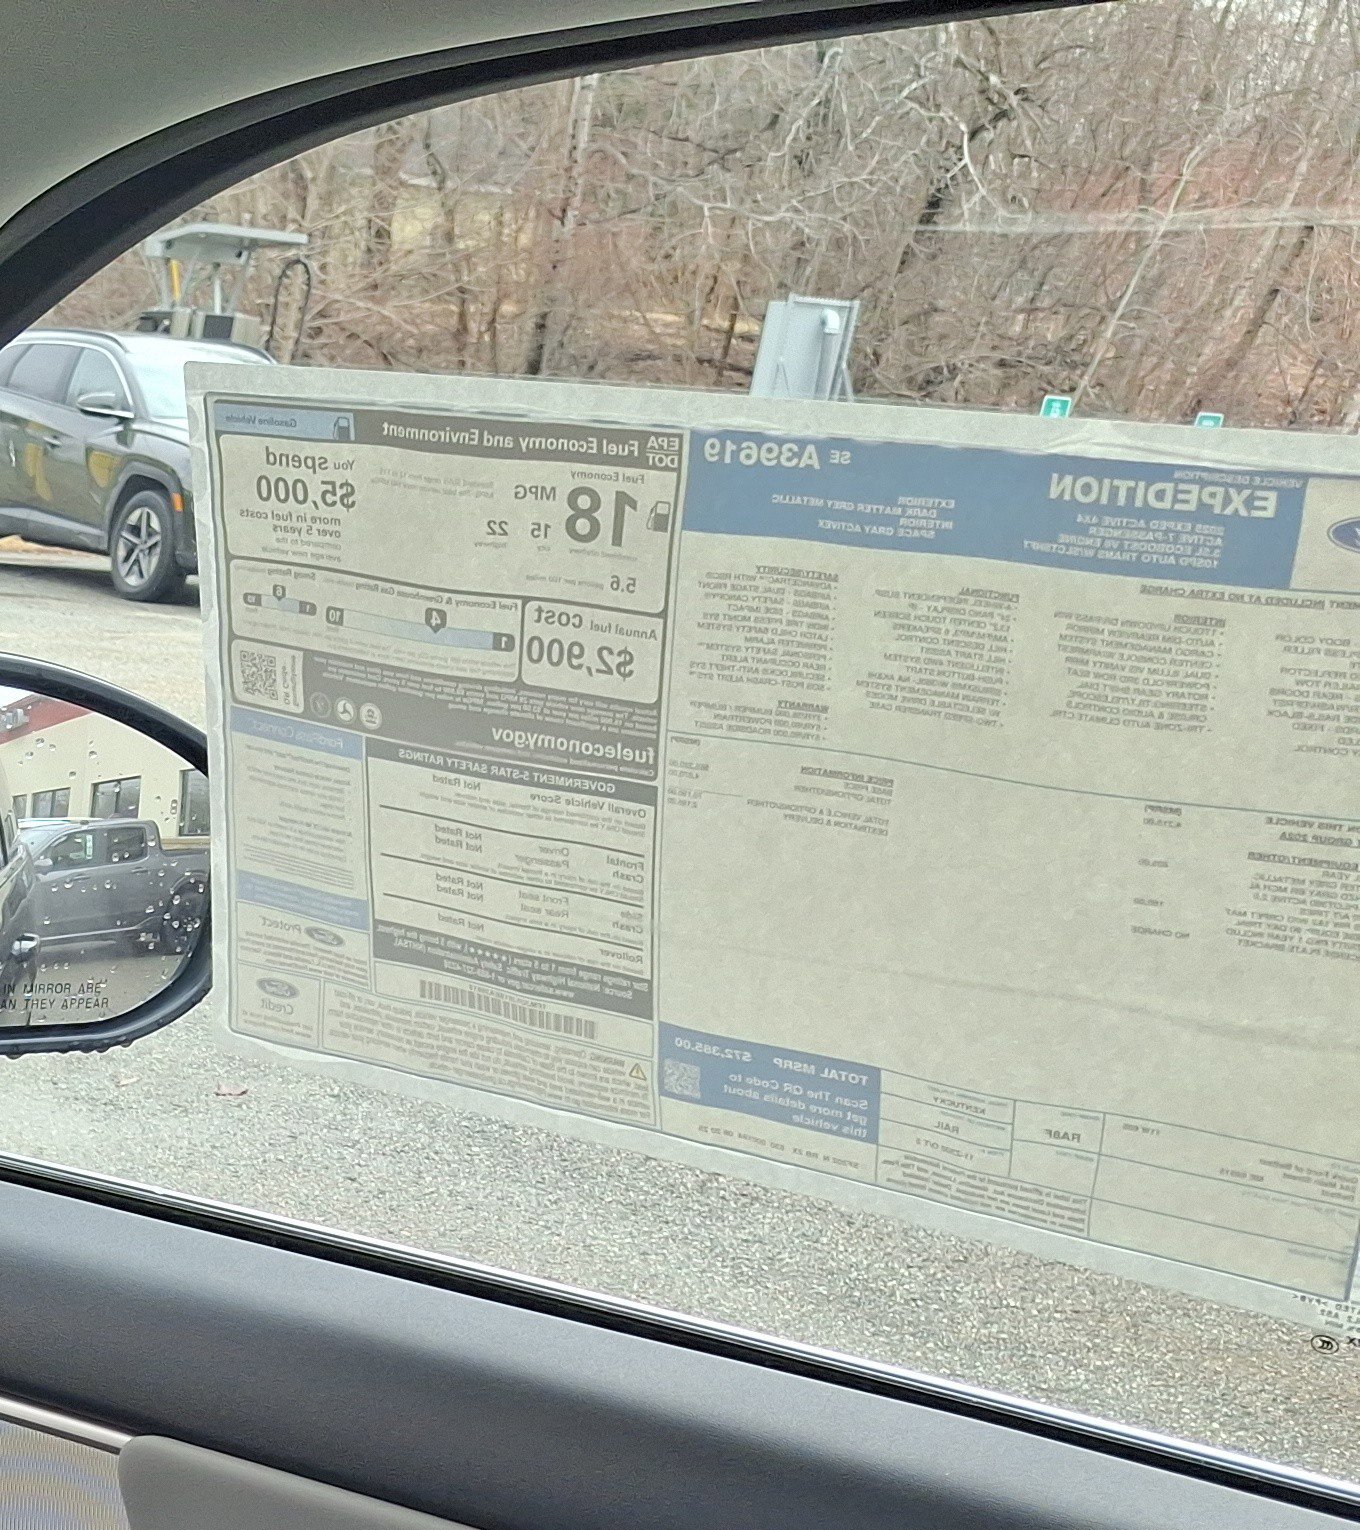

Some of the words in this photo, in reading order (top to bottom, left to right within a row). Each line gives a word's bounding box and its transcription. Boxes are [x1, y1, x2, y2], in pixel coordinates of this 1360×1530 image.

[3, 983, 15, 995] IN
[23, 983, 71, 995] MIRROR
[25, 998, 55, 1010] THEY
[61, 997, 109, 1010] APPEAR
